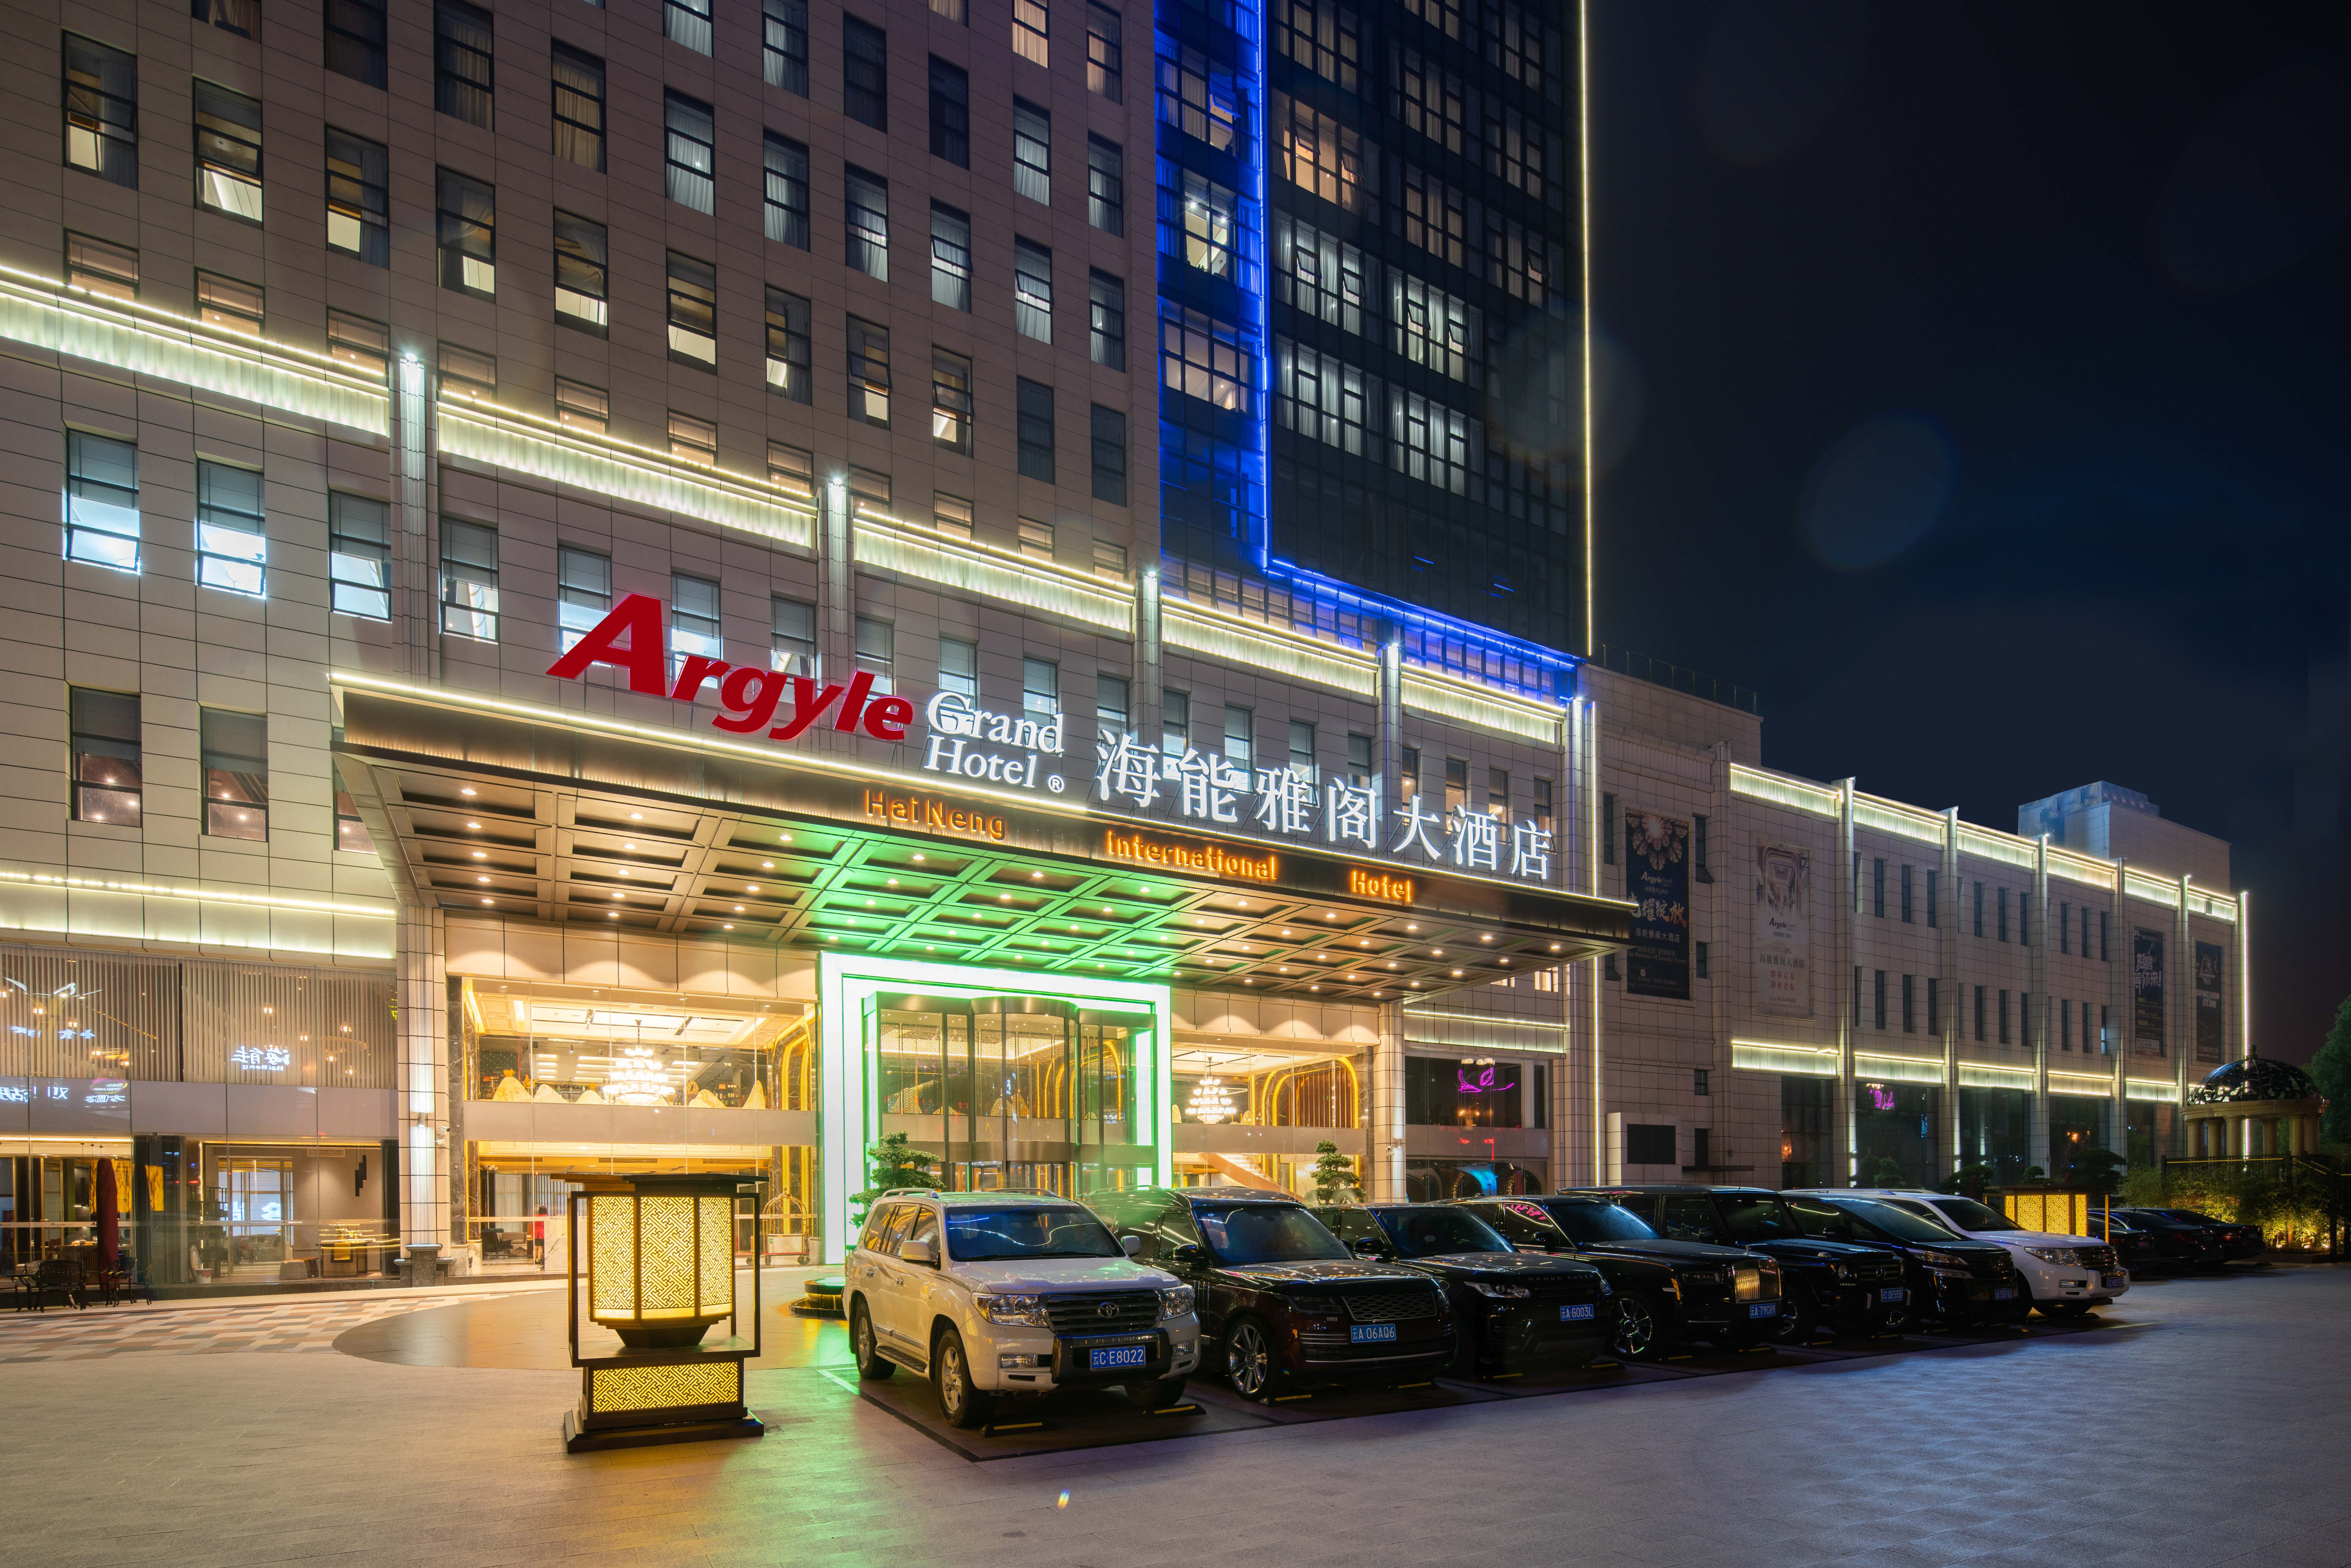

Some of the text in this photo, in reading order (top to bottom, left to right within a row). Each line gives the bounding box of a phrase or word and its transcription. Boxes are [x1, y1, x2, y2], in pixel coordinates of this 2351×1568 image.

[546, 593, 913, 741] Argyle
[927, 692, 1065, 754] Grand
[924, 734, 1038, 789] Hotel
[1095, 730, 1552, 880] 海能雅阁大酒店
[1108, 830, 1277, 880] International
[1352, 870, 1413, 902] Hotel
[1641, 871, 1662, 884] Argyle
[1769, 917, 1786, 929] Argyle
[1635, 927, 1680, 943] 海能雅阁大酒店
[1659, 955, 1673, 963] Luxury
[1760, 953, 1805, 969] 海能雅阁大酒店
[2136, 953, 2153, 971] 招聘
[1771, 970, 1795, 980] 即将启幕
[1771, 980, 1795, 991] 静候君临
[2203, 999, 2216, 1008] CLUB
[1562, 1306, 1593, 1318] 云A·G003L
[1751, 1304, 1776, 1316] 云A·79CH9
[1352, 1326, 1395, 1340] 云A·06AQ6
[1093, 1349, 1144, 1365] 云C·E8022
